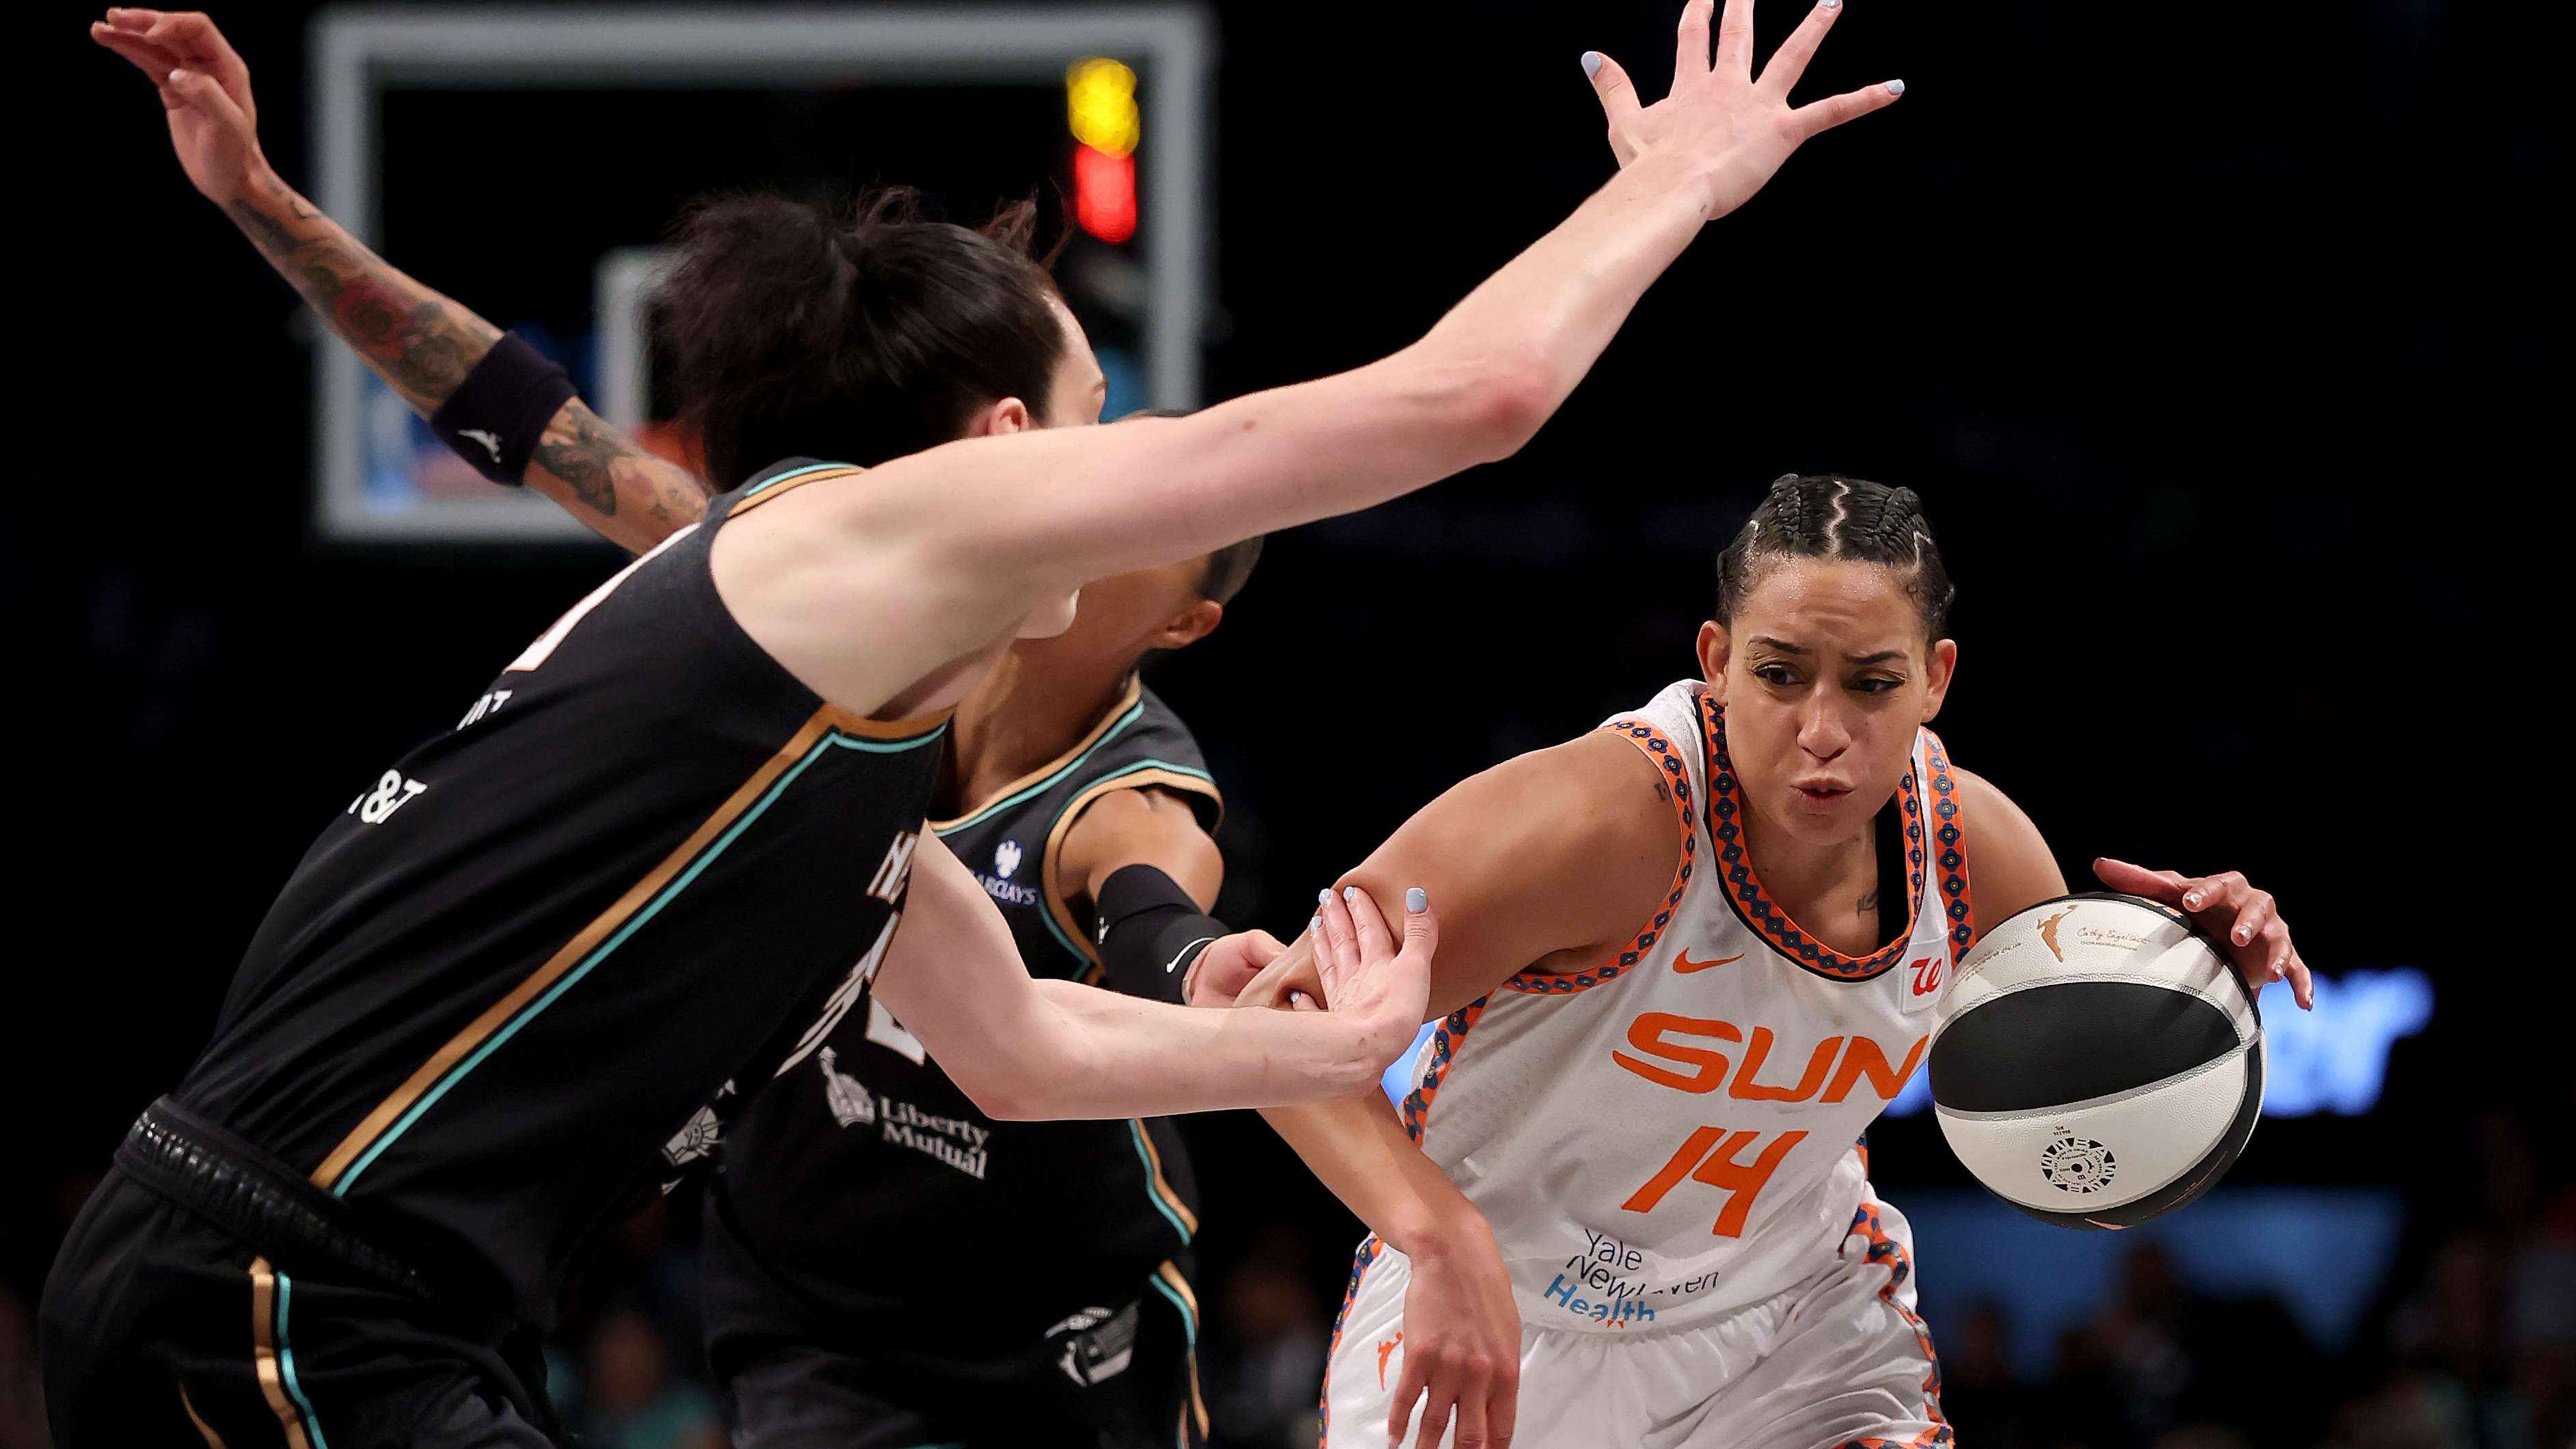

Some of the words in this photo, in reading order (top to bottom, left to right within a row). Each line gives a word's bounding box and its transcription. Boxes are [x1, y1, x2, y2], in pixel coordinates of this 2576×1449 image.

[1613, 1012, 1930, 1102] SUN
[881, 1096, 989, 1155] Liberty
[884, 1120, 987, 1180] Mutual
[1621, 1126, 1810, 1238] 14
[1585, 1228, 1642, 1271] Yale
[1544, 1273, 1655, 1322] Health
